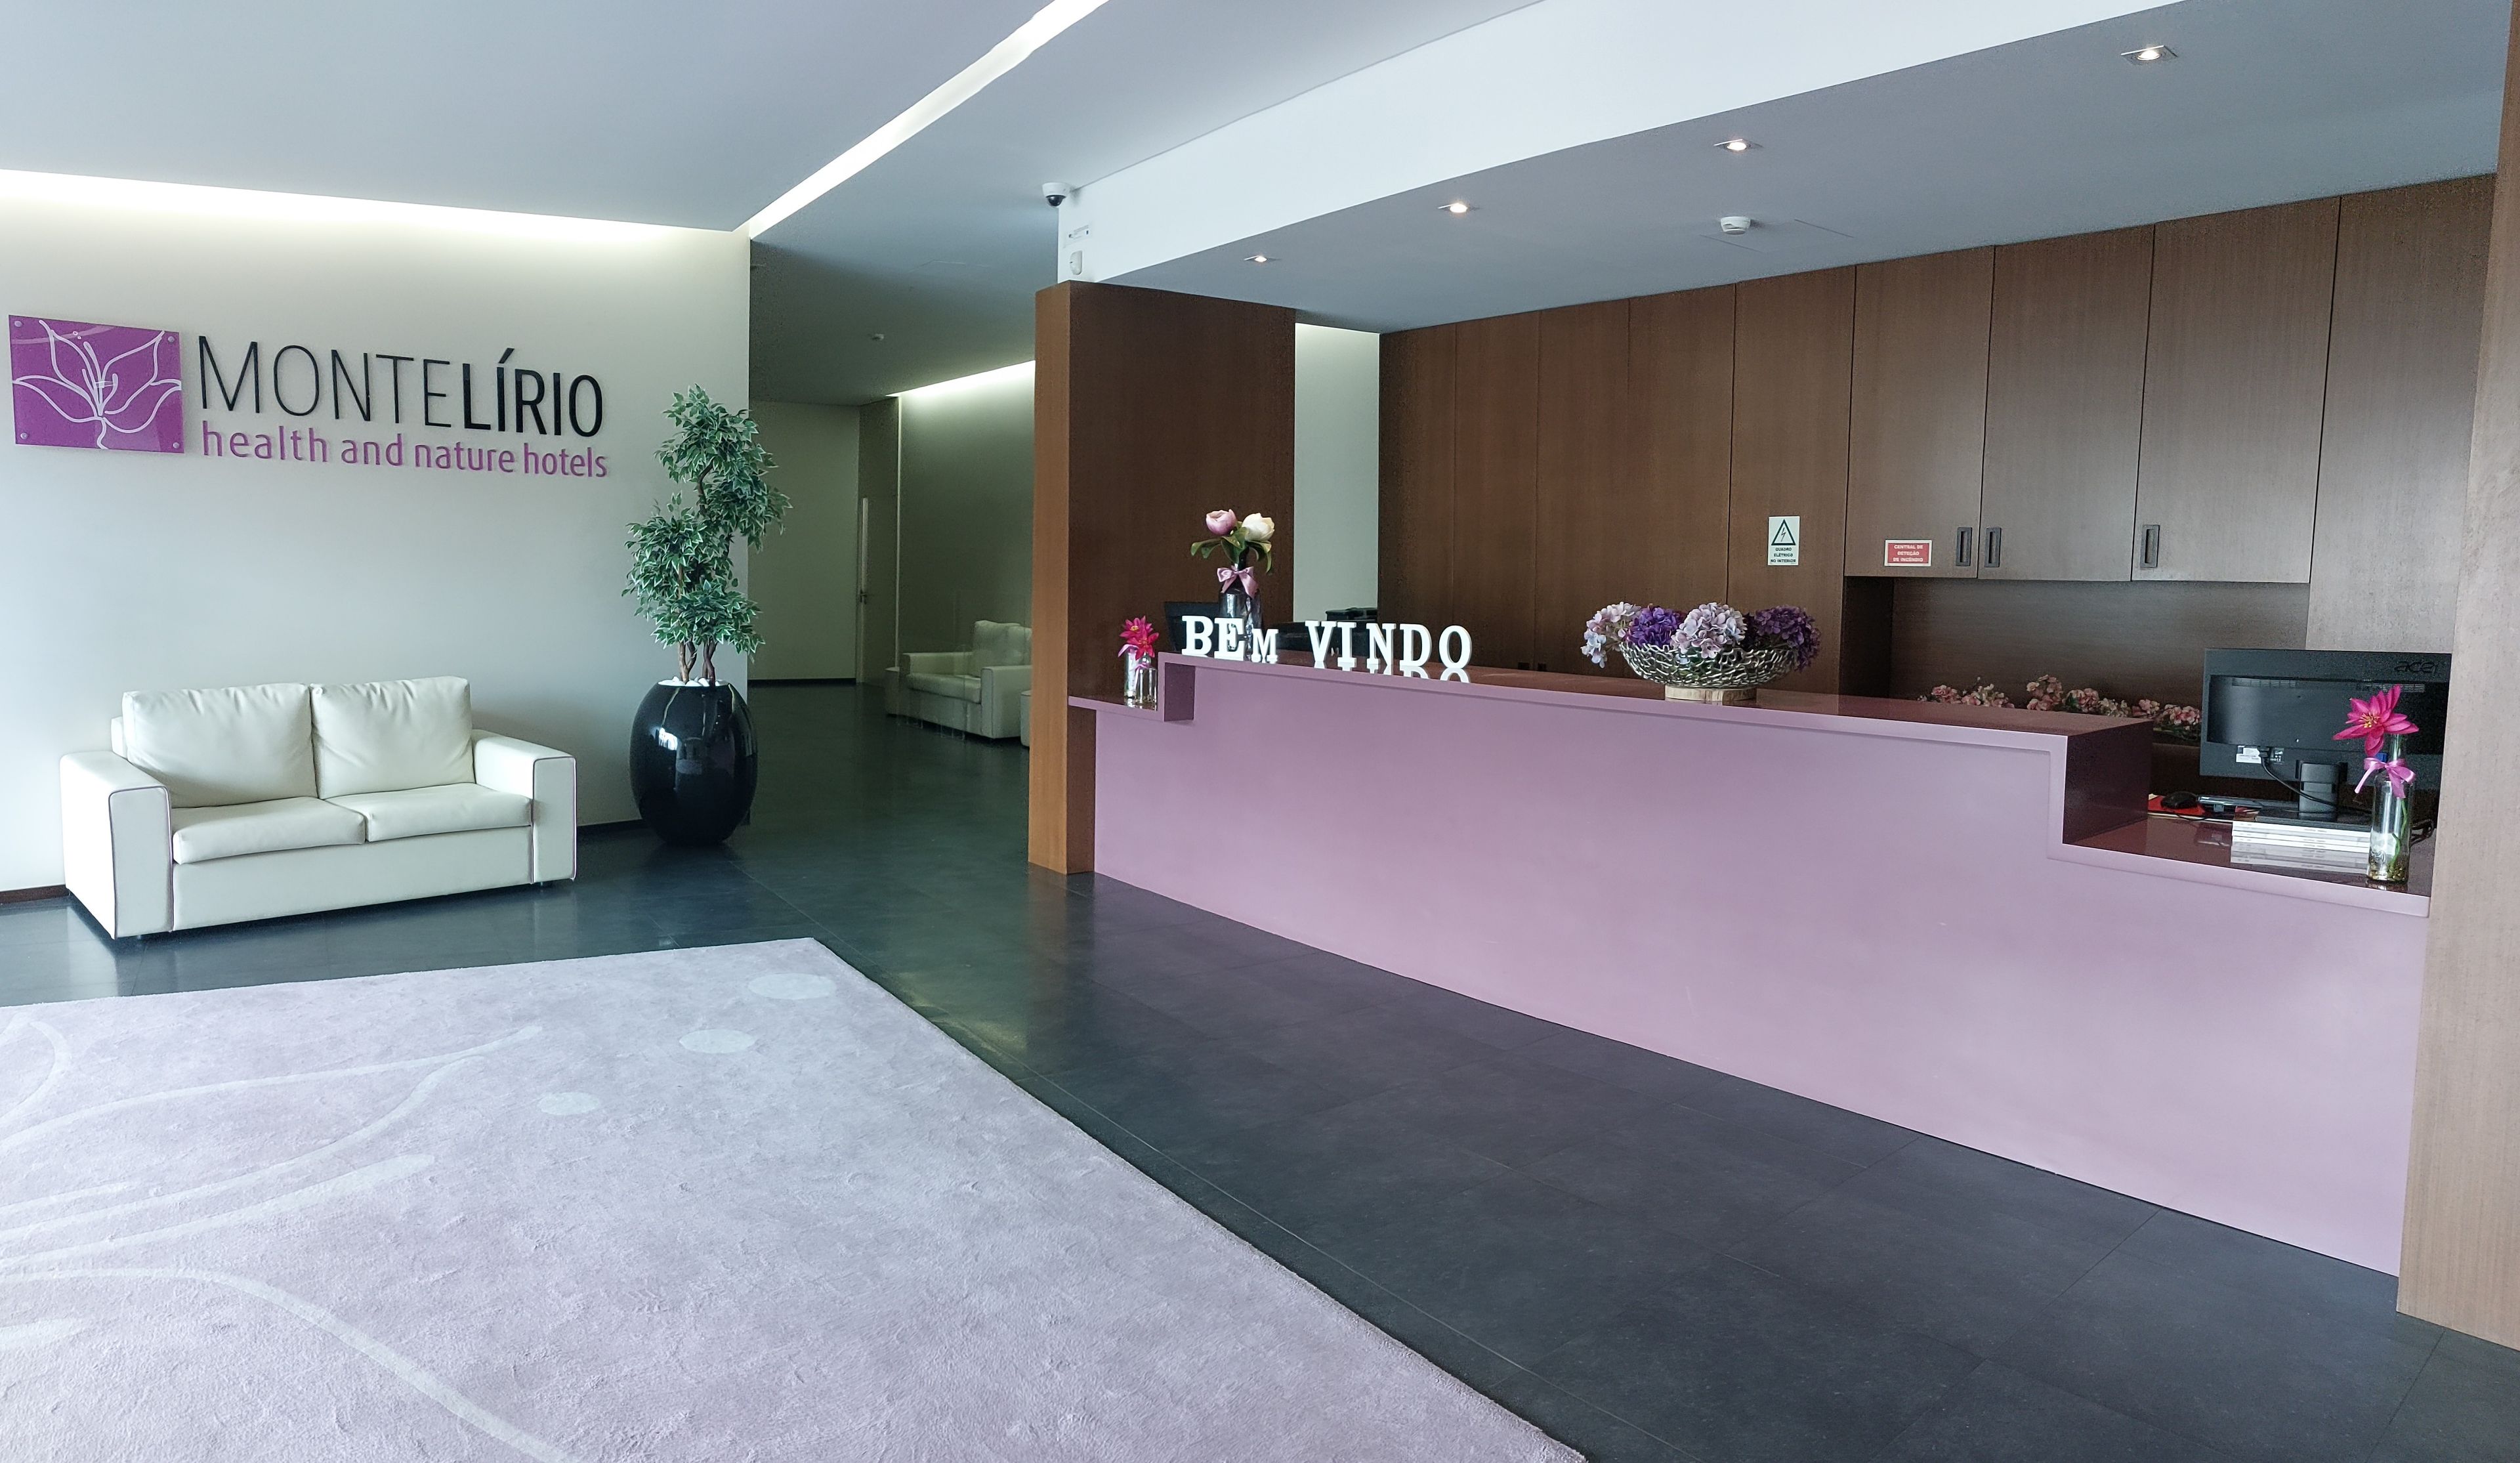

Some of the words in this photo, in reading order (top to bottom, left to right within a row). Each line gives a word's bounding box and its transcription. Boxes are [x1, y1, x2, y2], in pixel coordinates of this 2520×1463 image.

[198, 335, 603, 437] MONTELÍRIO
[202, 420, 328, 463] health
[341, 433, 404, 467] and
[414, 441, 515, 473] nature
[523, 442, 608, 478] hotels
[1182, 615, 1279, 661] BEM
[1305, 620, 1473, 669] VINDO
